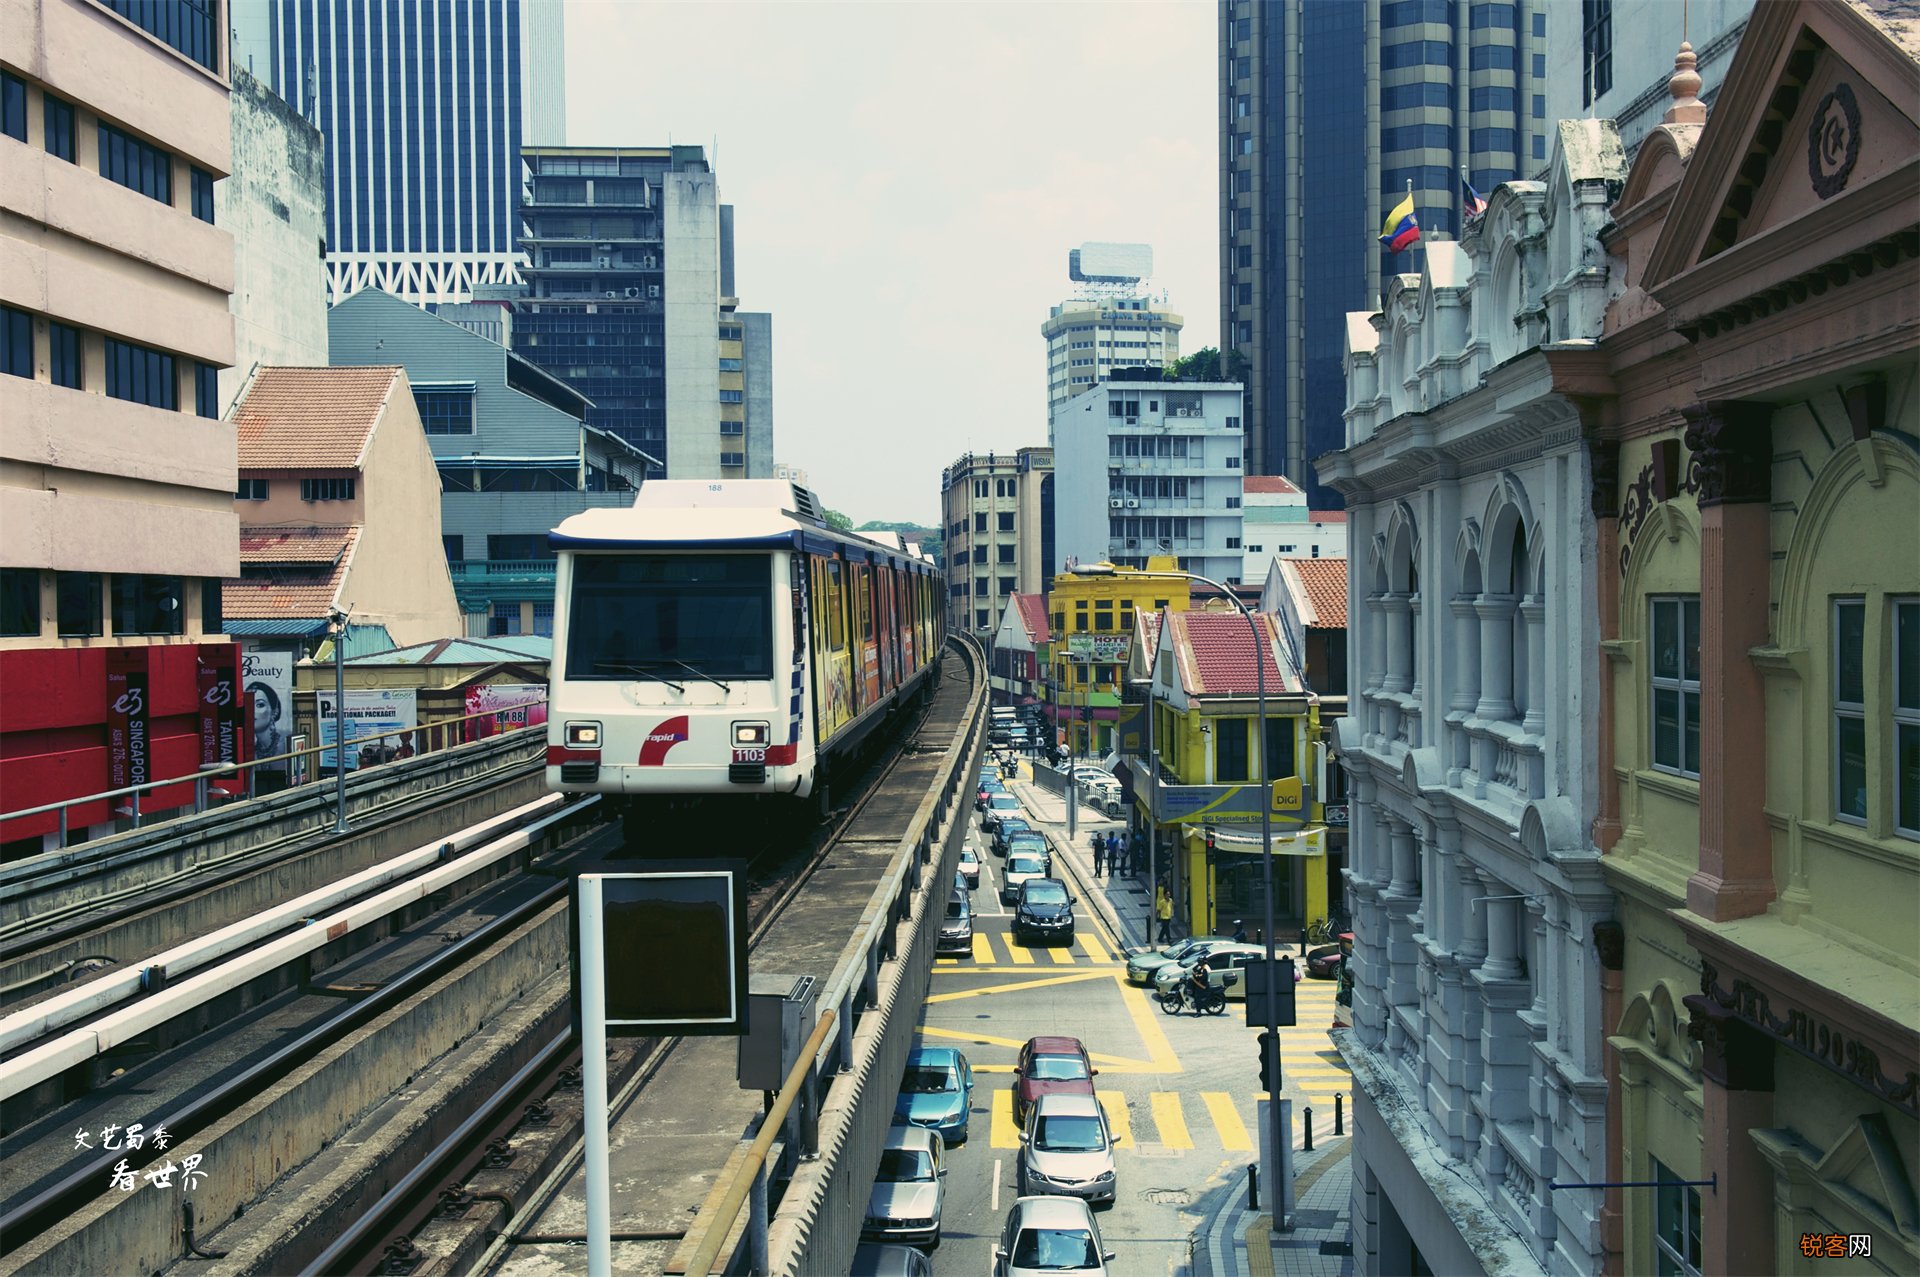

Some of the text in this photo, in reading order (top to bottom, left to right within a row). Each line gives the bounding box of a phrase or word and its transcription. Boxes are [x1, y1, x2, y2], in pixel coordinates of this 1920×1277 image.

[1034, 457, 1052, 466] WISMA
[242, 656, 283, 679] Beauty
[320, 700, 364, 719] PROTIONAL
[646, 733, 675, 743] rapid
[129, 720, 145, 785] SINGAPOR
[736, 749, 766, 761] 1103
[1276, 795, 1297, 805] DiGi
[1215, 815, 1250, 824] Specialised
[1250, 815, 1264, 823] Stor
